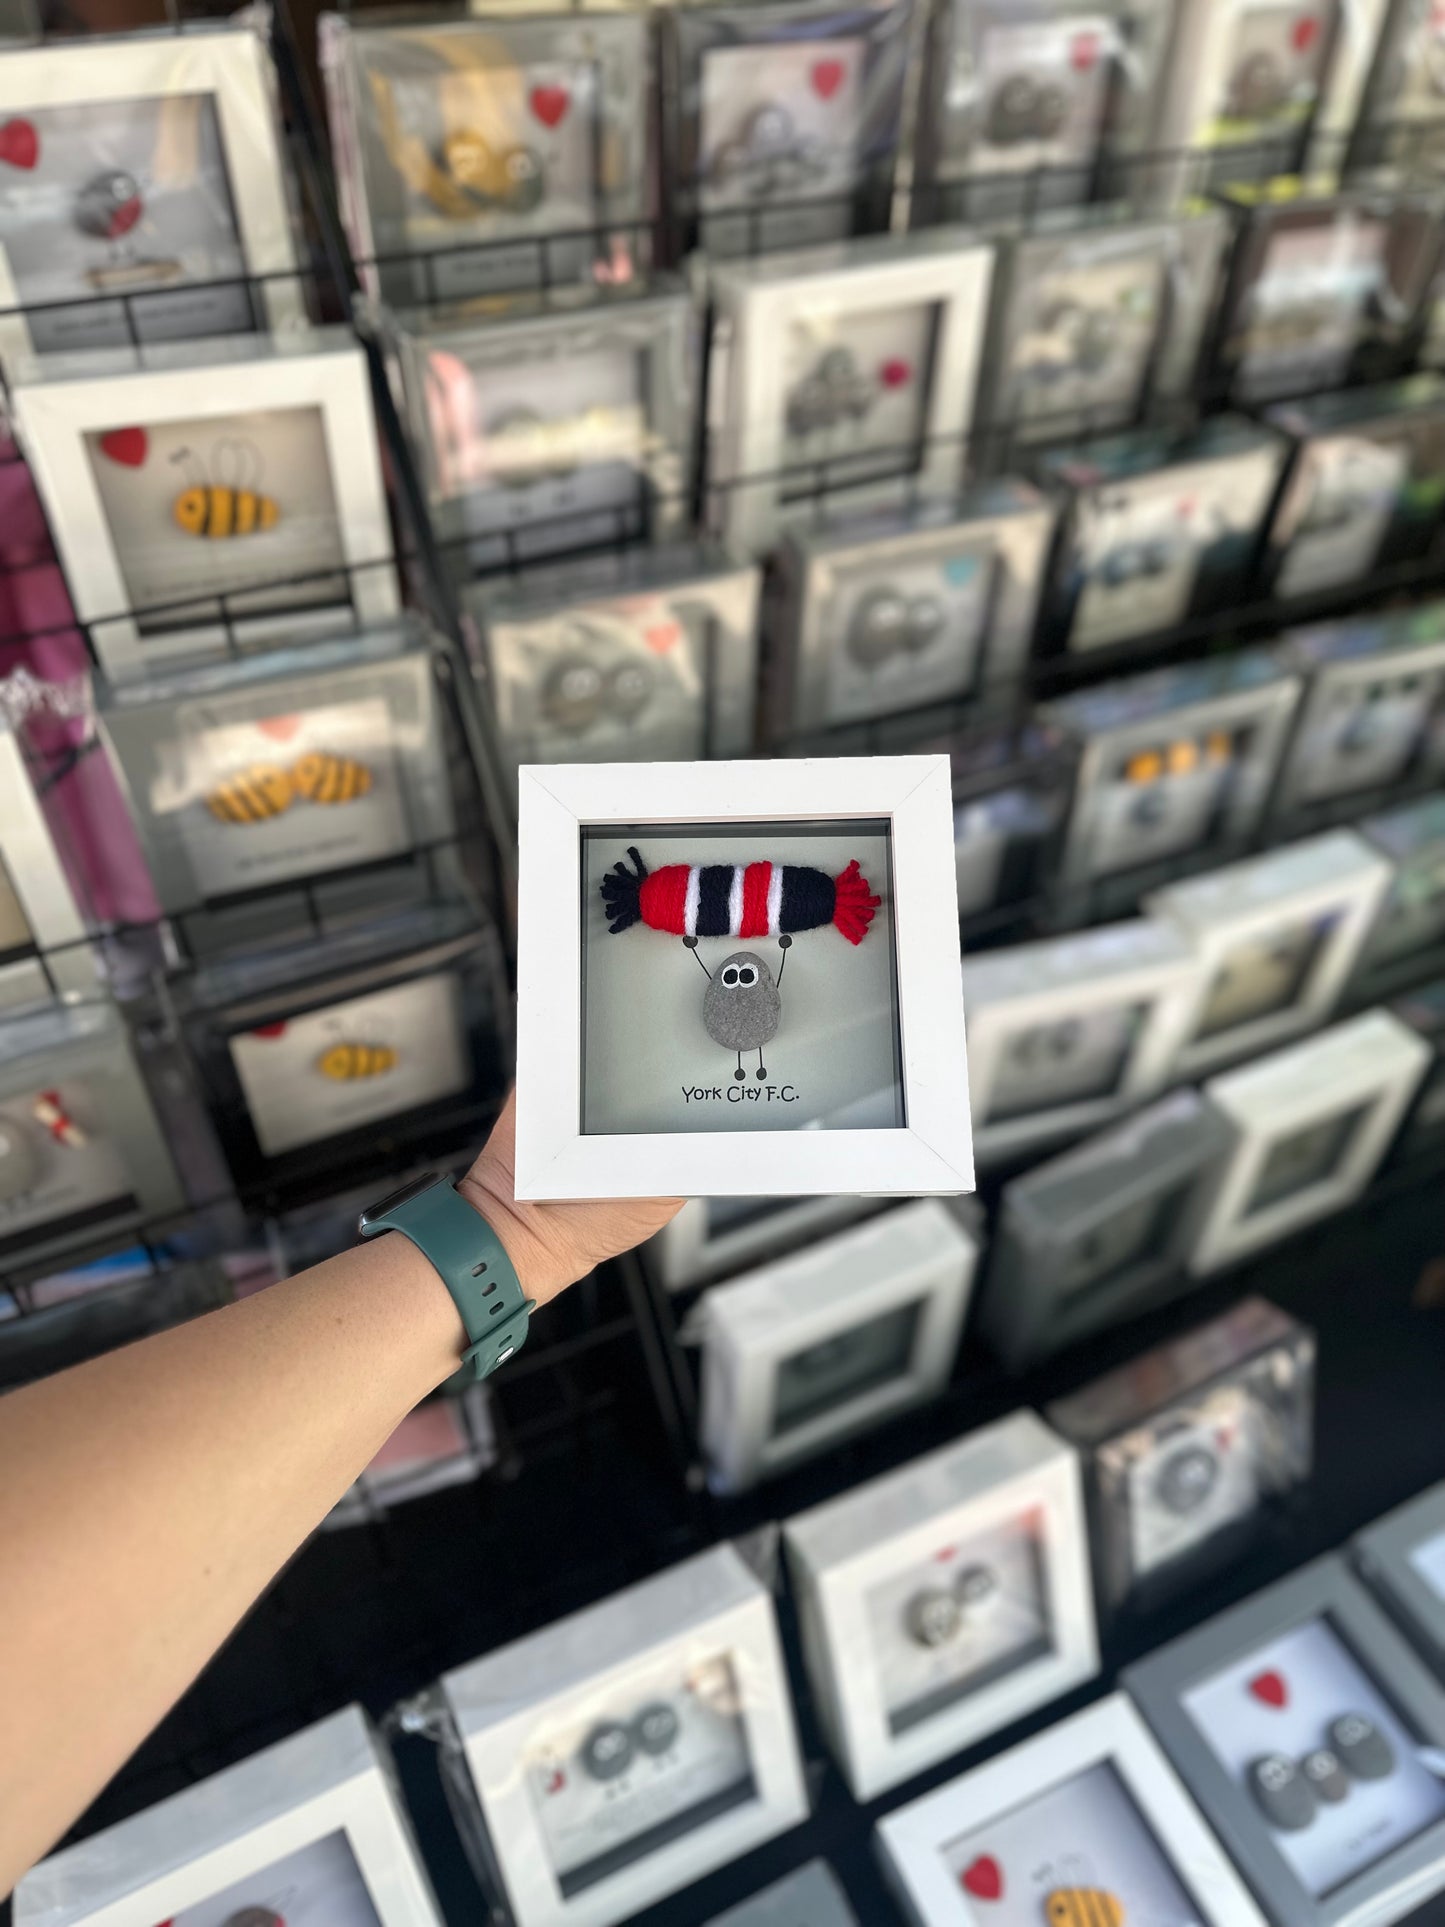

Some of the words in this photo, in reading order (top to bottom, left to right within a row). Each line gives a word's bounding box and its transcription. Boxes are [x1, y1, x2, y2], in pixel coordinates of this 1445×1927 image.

[681, 1086, 722, 1104] York
[726, 1085, 762, 1103] City
[765, 1085, 800, 1103] F.C.
